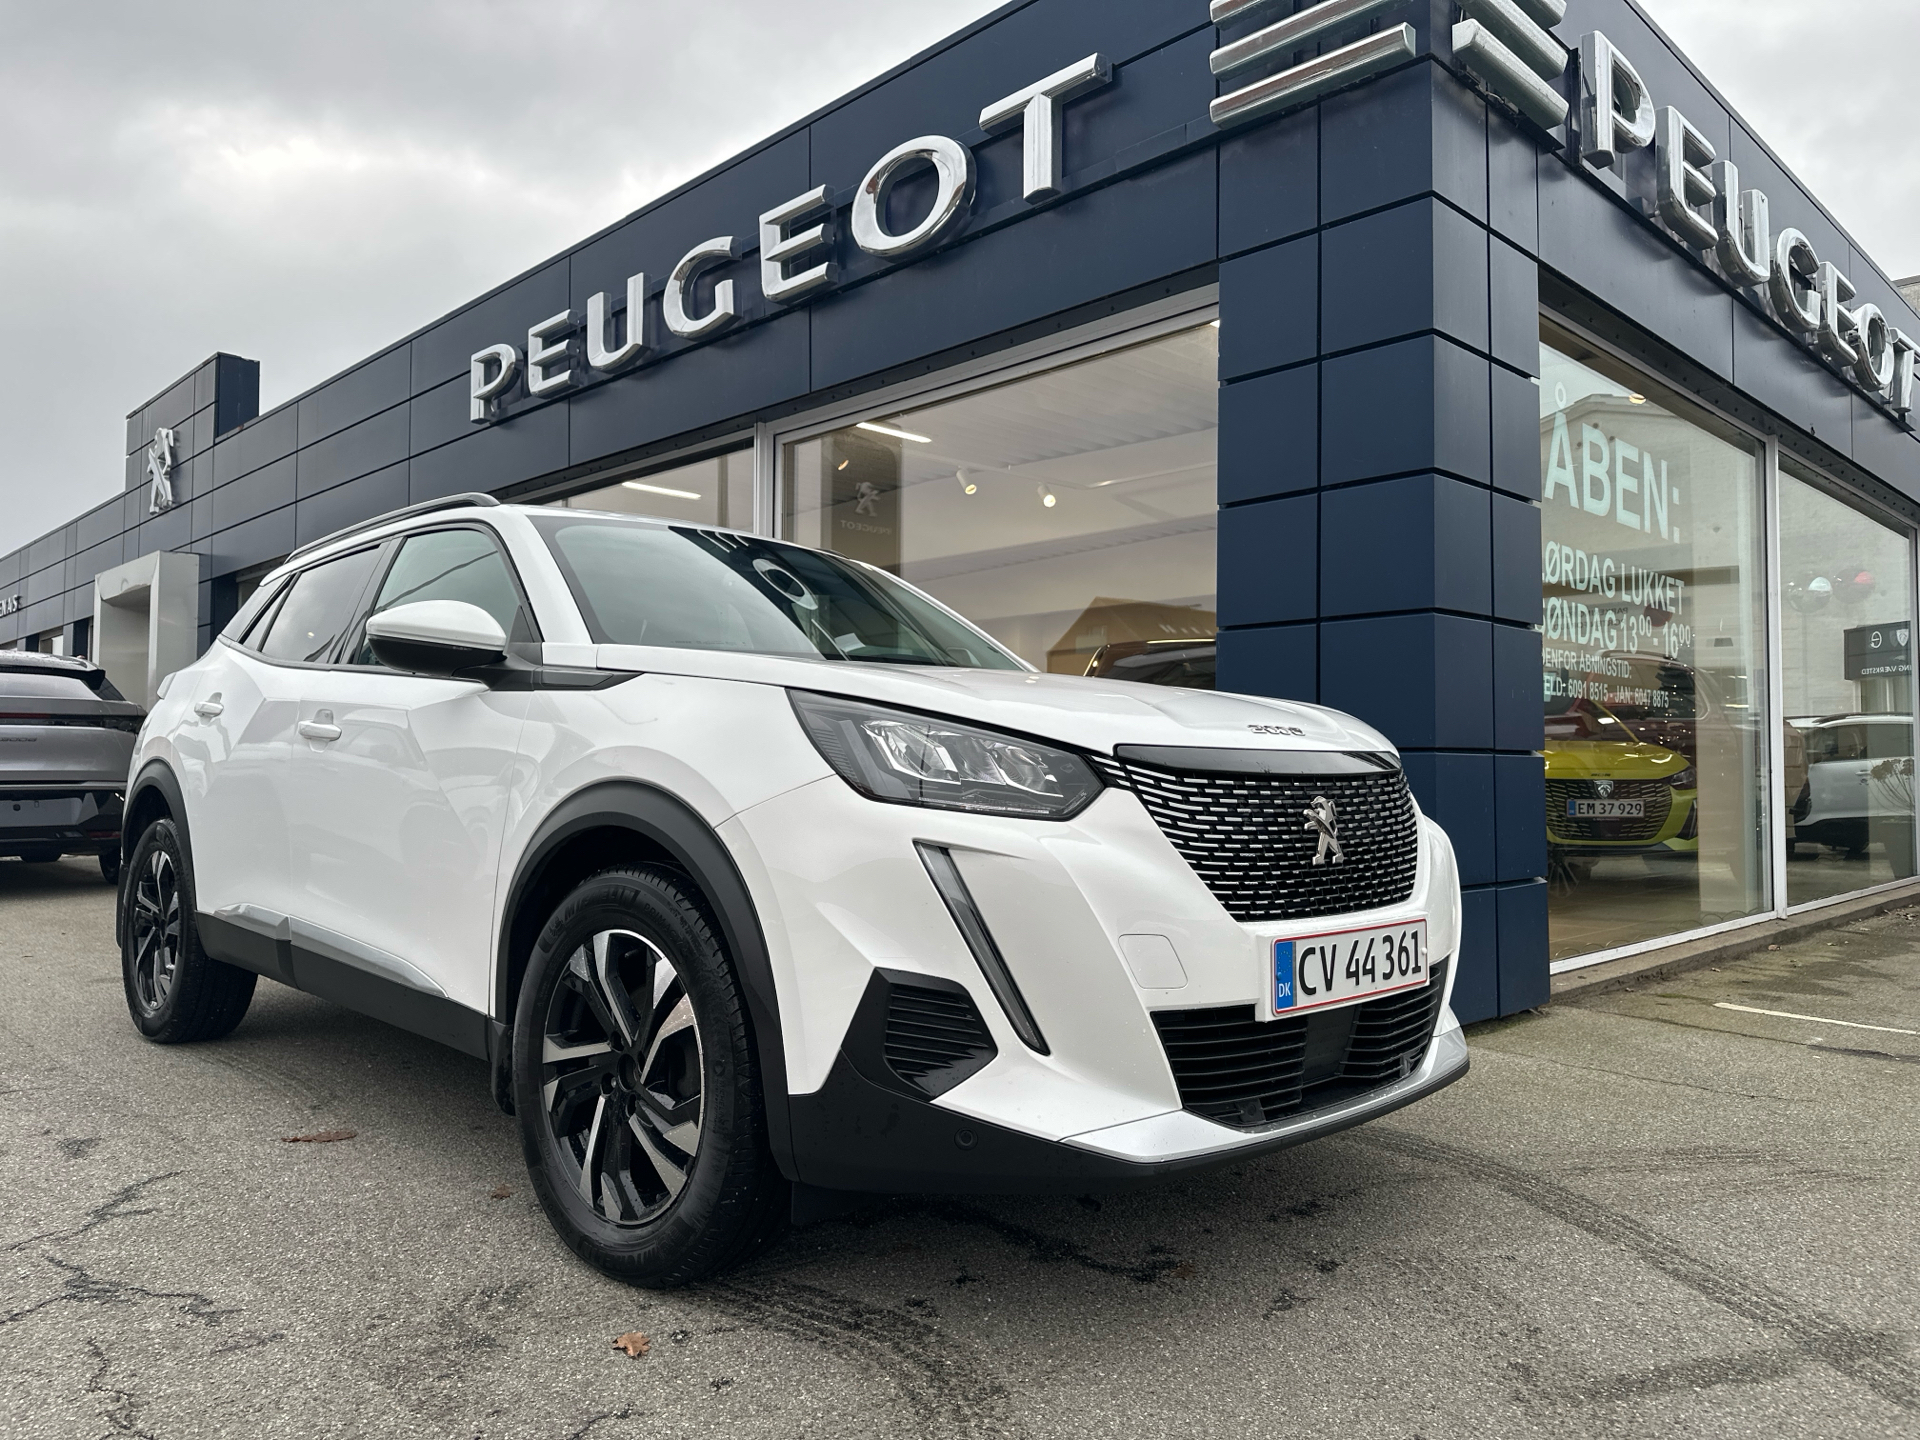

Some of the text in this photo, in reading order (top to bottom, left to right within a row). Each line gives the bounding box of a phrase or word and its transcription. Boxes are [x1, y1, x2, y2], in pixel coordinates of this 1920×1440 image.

[471, 52, 1111, 425] PEUGEOT
[1580, 30, 1920, 414] PEUGEOT
[1544, 381, 1680, 544] ÅBEN:
[1542, 540, 1685, 615] ØRDAG LUKKET
[1568, 679, 1587, 699] 6091
[1589, 681, 1608, 702] 8515
[1578, 803, 1642, 815] EM 37 929
[1278, 982, 1291, 997] DK
[1299, 943, 1337, 996] CV
